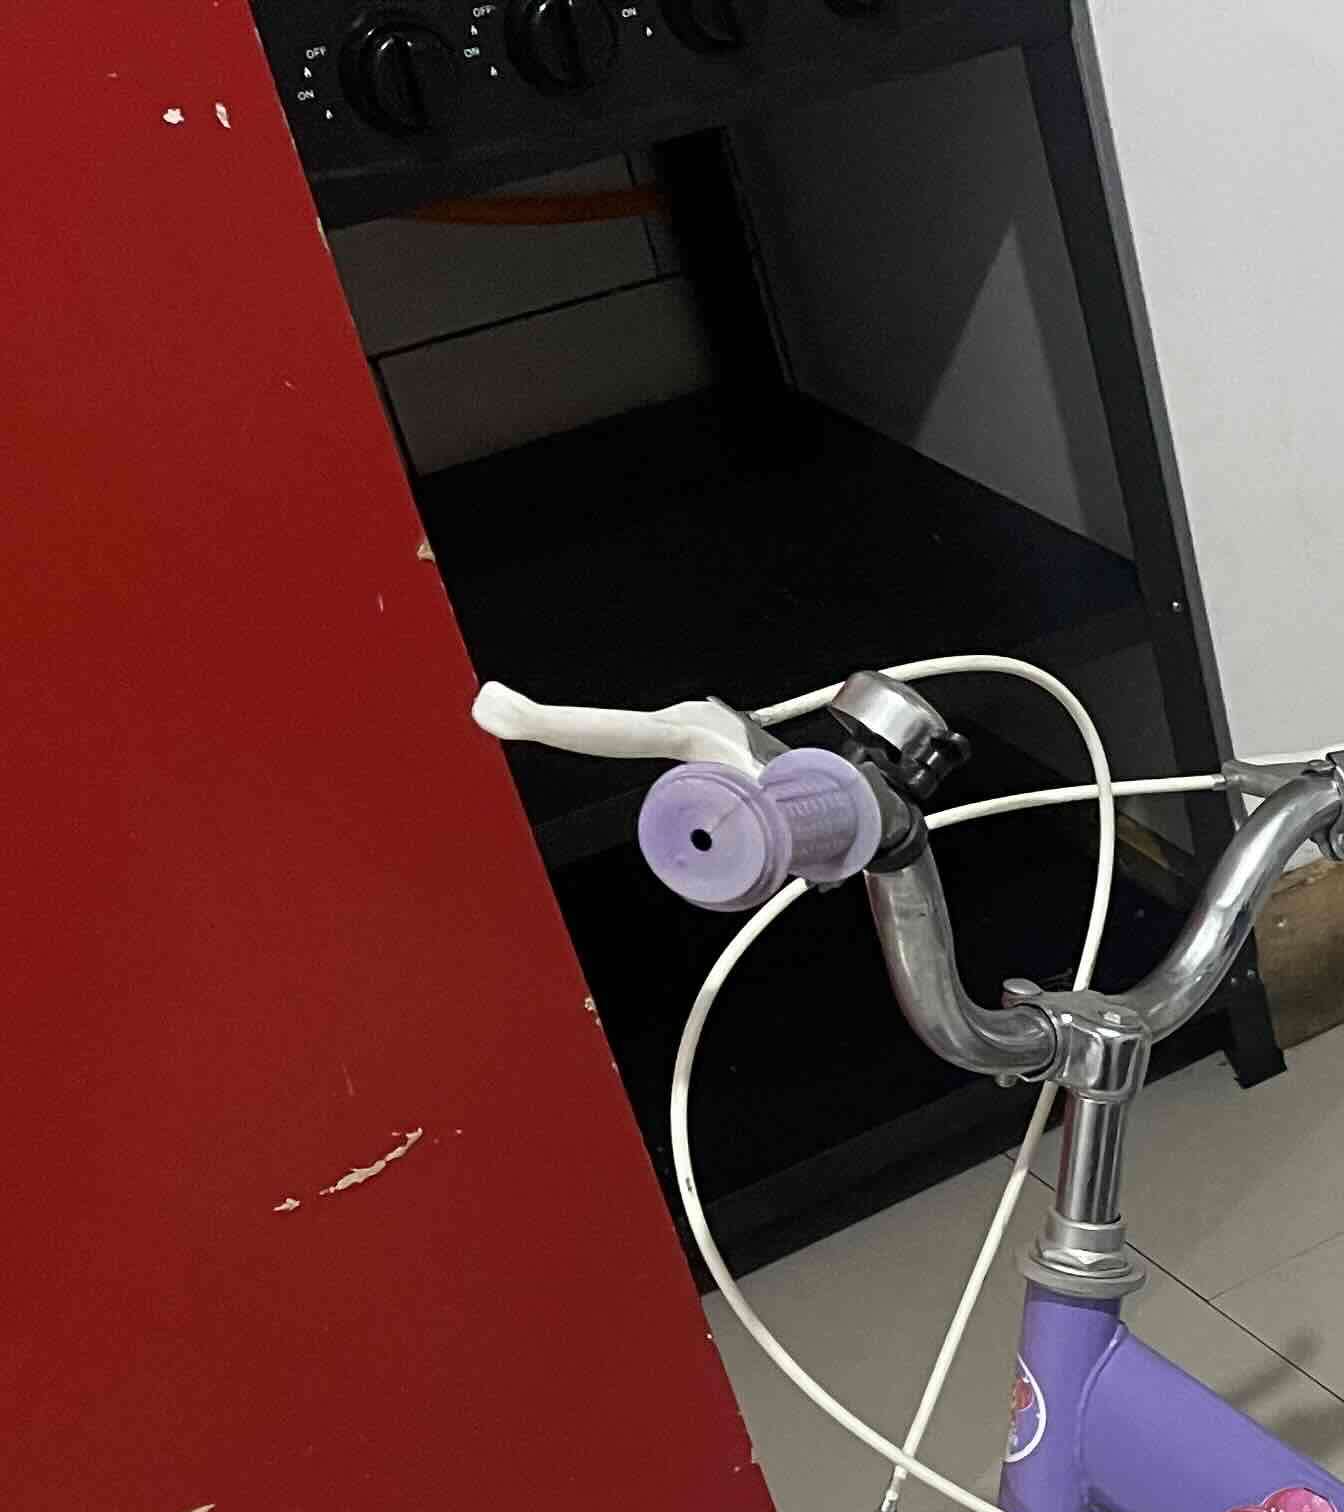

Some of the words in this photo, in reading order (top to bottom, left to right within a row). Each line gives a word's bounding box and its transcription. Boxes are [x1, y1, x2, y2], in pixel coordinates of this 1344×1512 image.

[621, 7, 637, 18] ON
[305, 45, 327, 59] OFF
[463, 46, 480, 58] ON
[297, 89, 315, 101] ON
